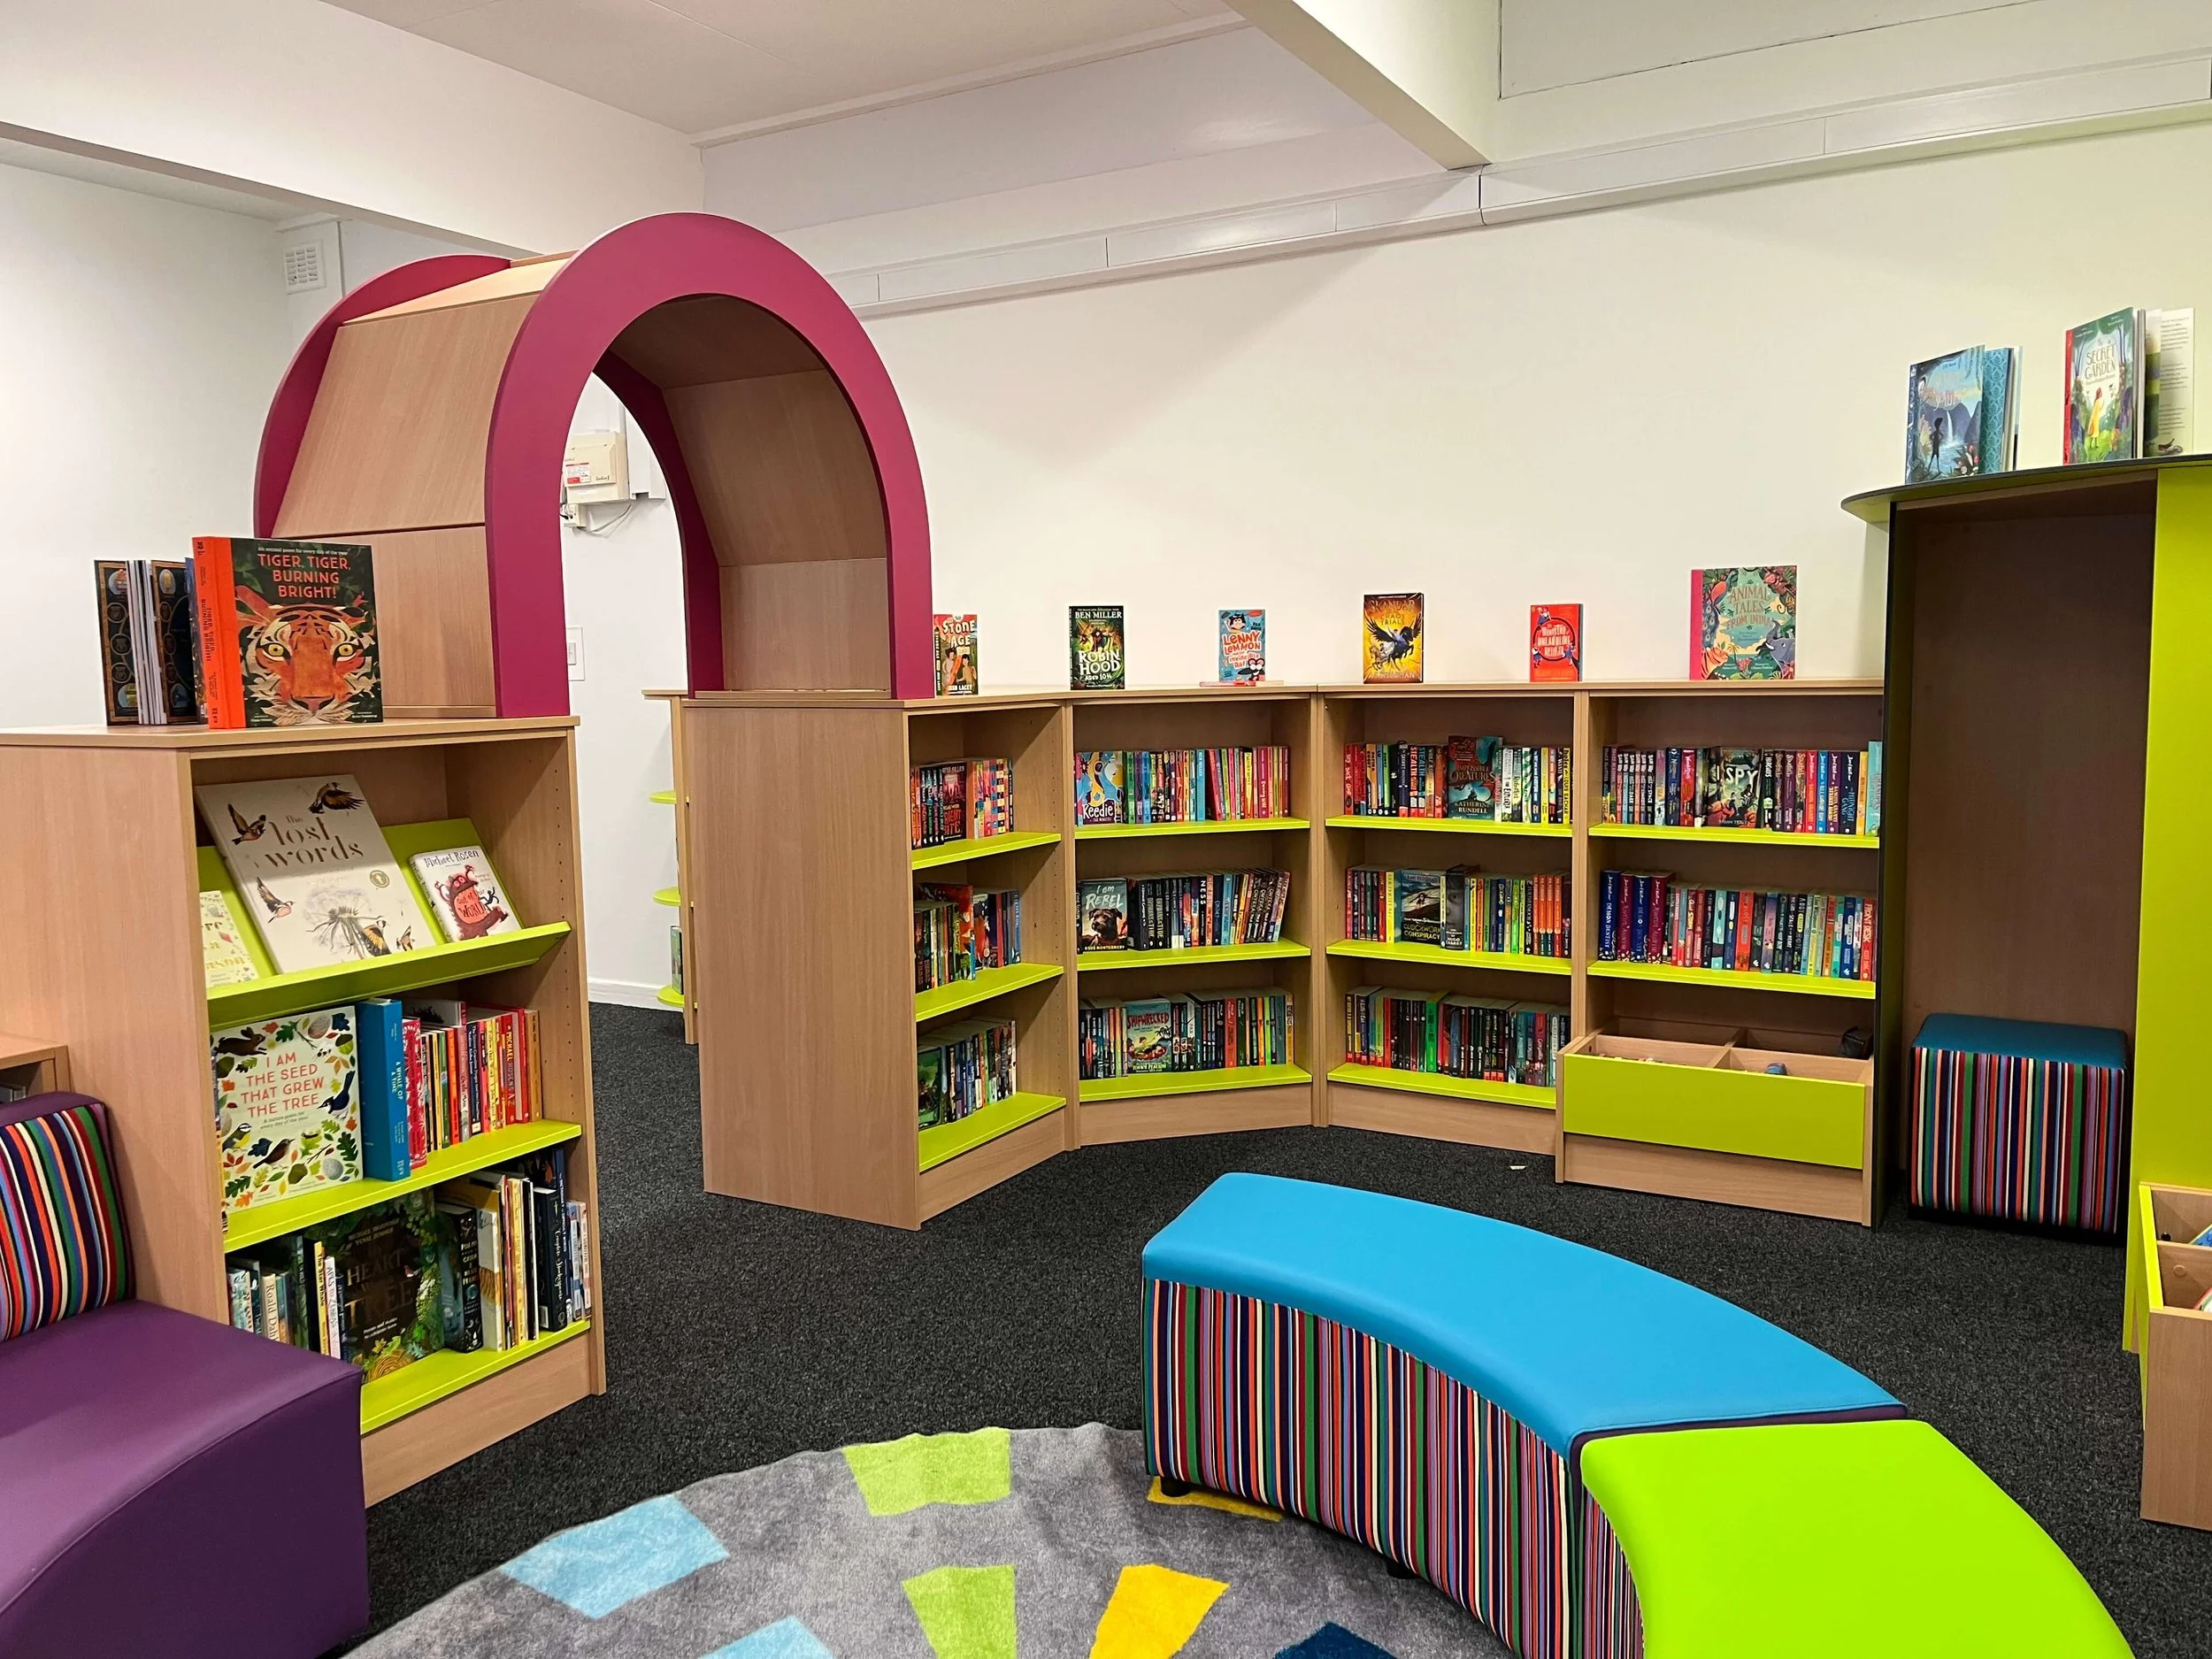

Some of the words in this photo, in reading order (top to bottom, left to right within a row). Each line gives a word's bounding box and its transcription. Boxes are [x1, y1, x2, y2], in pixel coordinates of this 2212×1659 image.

[2086, 345, 2116, 365] SECRET
[2085, 360, 2116, 380] GARDEN
[257, 554, 303, 568] TIGER,
[306, 556, 351, 570] TIGER,
[273, 570, 340, 584] BURNING
[279, 585, 337, 599] BRIGHT!
[1727, 586, 1769, 602] ANIMAL
[1734, 601, 1764, 615] TALES
[942, 619, 976, 634] STONE
[1727, 615, 1747, 629] FROM
[951, 634, 972, 649] AGE
[1078, 649, 1121, 664] ROBIN
[1079, 660, 1121, 676] HOOD
[1083, 803, 1114, 819] Keedie
[268, 817, 330, 845] lost
[265, 835, 364, 867] words
[424, 854, 454, 868] Michael
[454, 849, 480, 862] Rosen
[1097, 885, 1101, 894] I
[1086, 893, 1123, 910] REBEL
[1863, 903, 1873, 925] FRONT
[1404, 930, 1440, 940] CONSPIRACY
[1863, 926, 1872, 942] DESK
[505, 1031, 514, 1062] MICHAEL
[266, 1056, 270, 1069] I
[276, 1052, 297, 1066] AM
[246, 1071, 276, 1087] THE
[280, 1064, 318, 1080] SEED
[241, 1087, 278, 1104] THAT
[282, 1077, 325, 1095] GREW
[397, 1090, 403, 1101] OF
[248, 1102, 278, 1118] THE
[282, 1093, 319, 1111] TREE
[347, 1248, 405, 1286] HEART
[326, 1266, 334, 1286] APES
[554, 1257, 564, 1301] Shakespeare
[265, 1284, 276, 1313] Roald
[328, 1299, 339, 1328] ZEBRAS
[270, 1318, 280, 1340] Dahl
